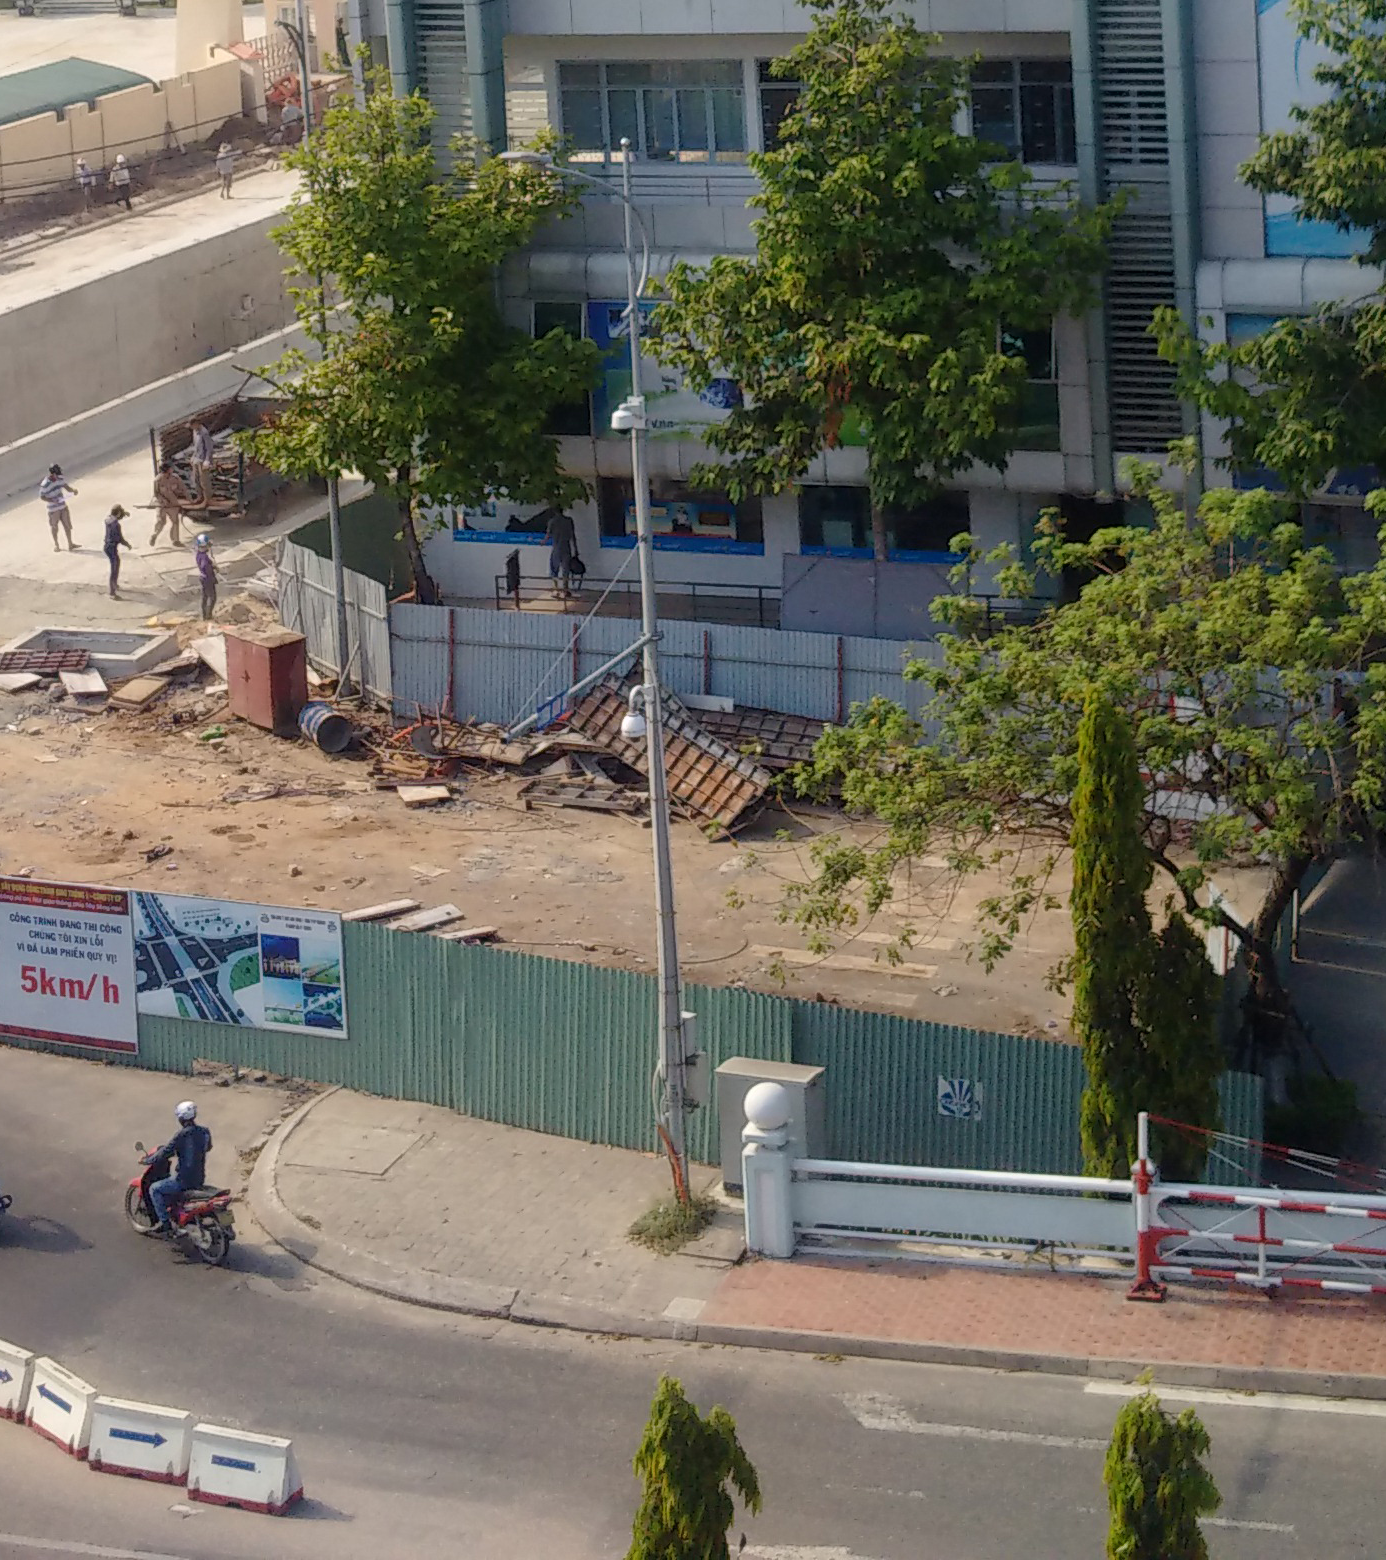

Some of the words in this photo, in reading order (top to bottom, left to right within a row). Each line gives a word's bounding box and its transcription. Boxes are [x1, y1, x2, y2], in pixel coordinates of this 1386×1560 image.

[84, 922, 97, 932] THI
[74, 935, 87, 946] XIN
[21, 965, 120, 1004] 5km/h
